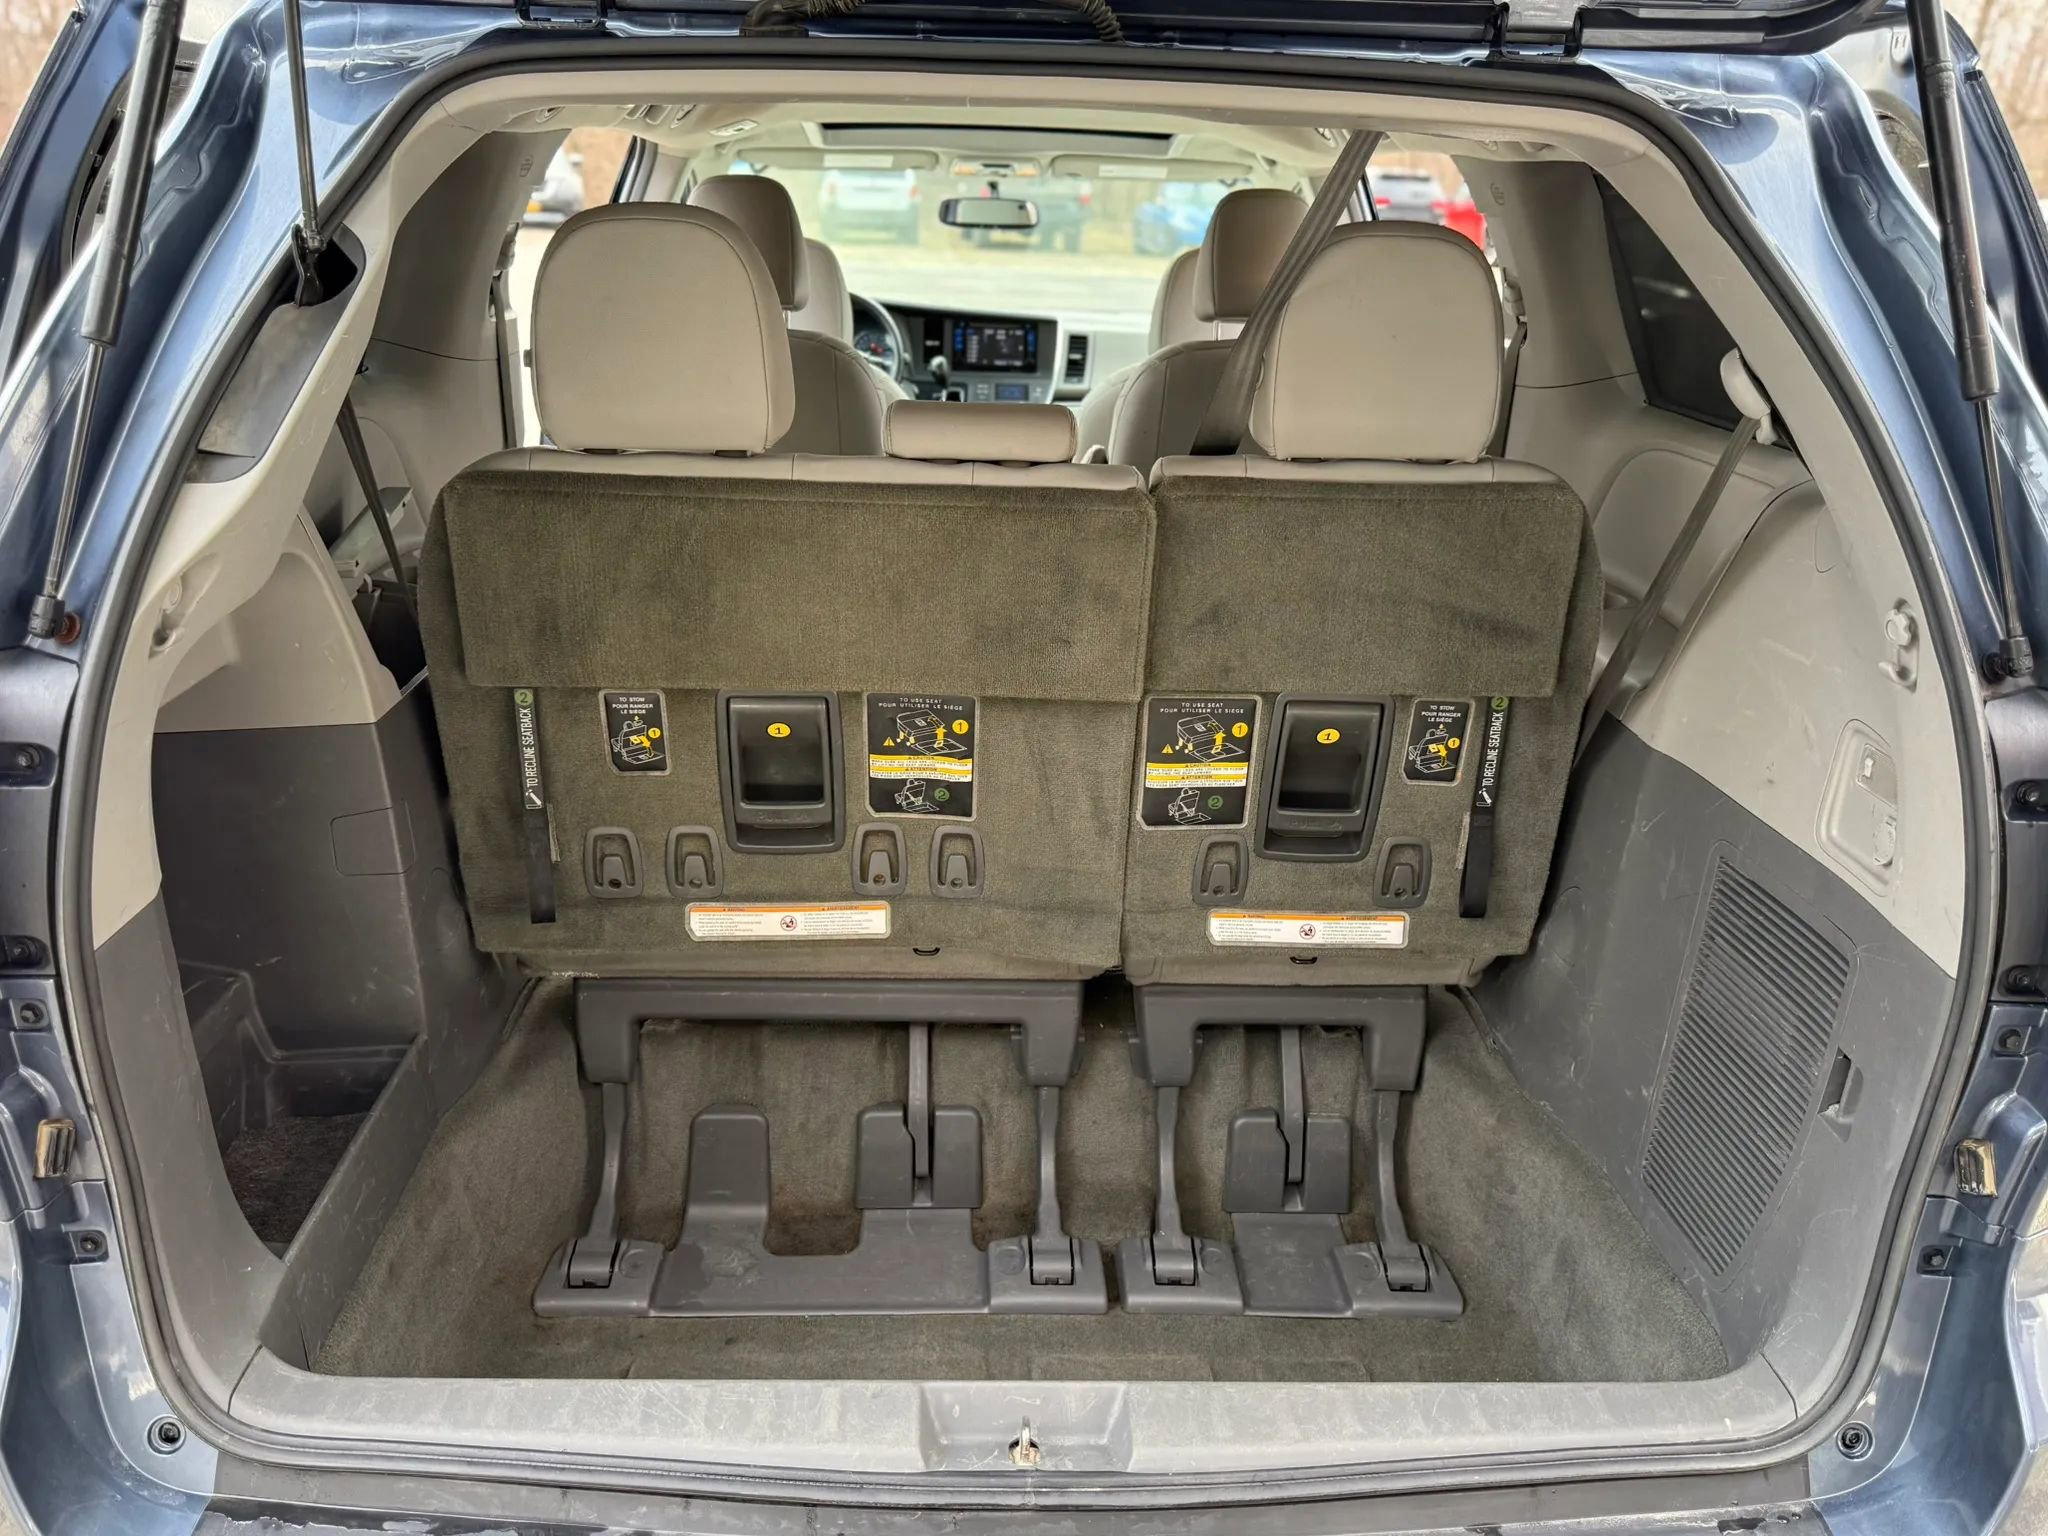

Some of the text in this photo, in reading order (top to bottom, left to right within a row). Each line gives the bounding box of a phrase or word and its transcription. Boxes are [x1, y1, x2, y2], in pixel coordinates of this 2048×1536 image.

[519, 707, 539, 789] TO RECLINE SEATBACK
[1482, 712, 1504, 787] TO RECLINE SEATBACK
